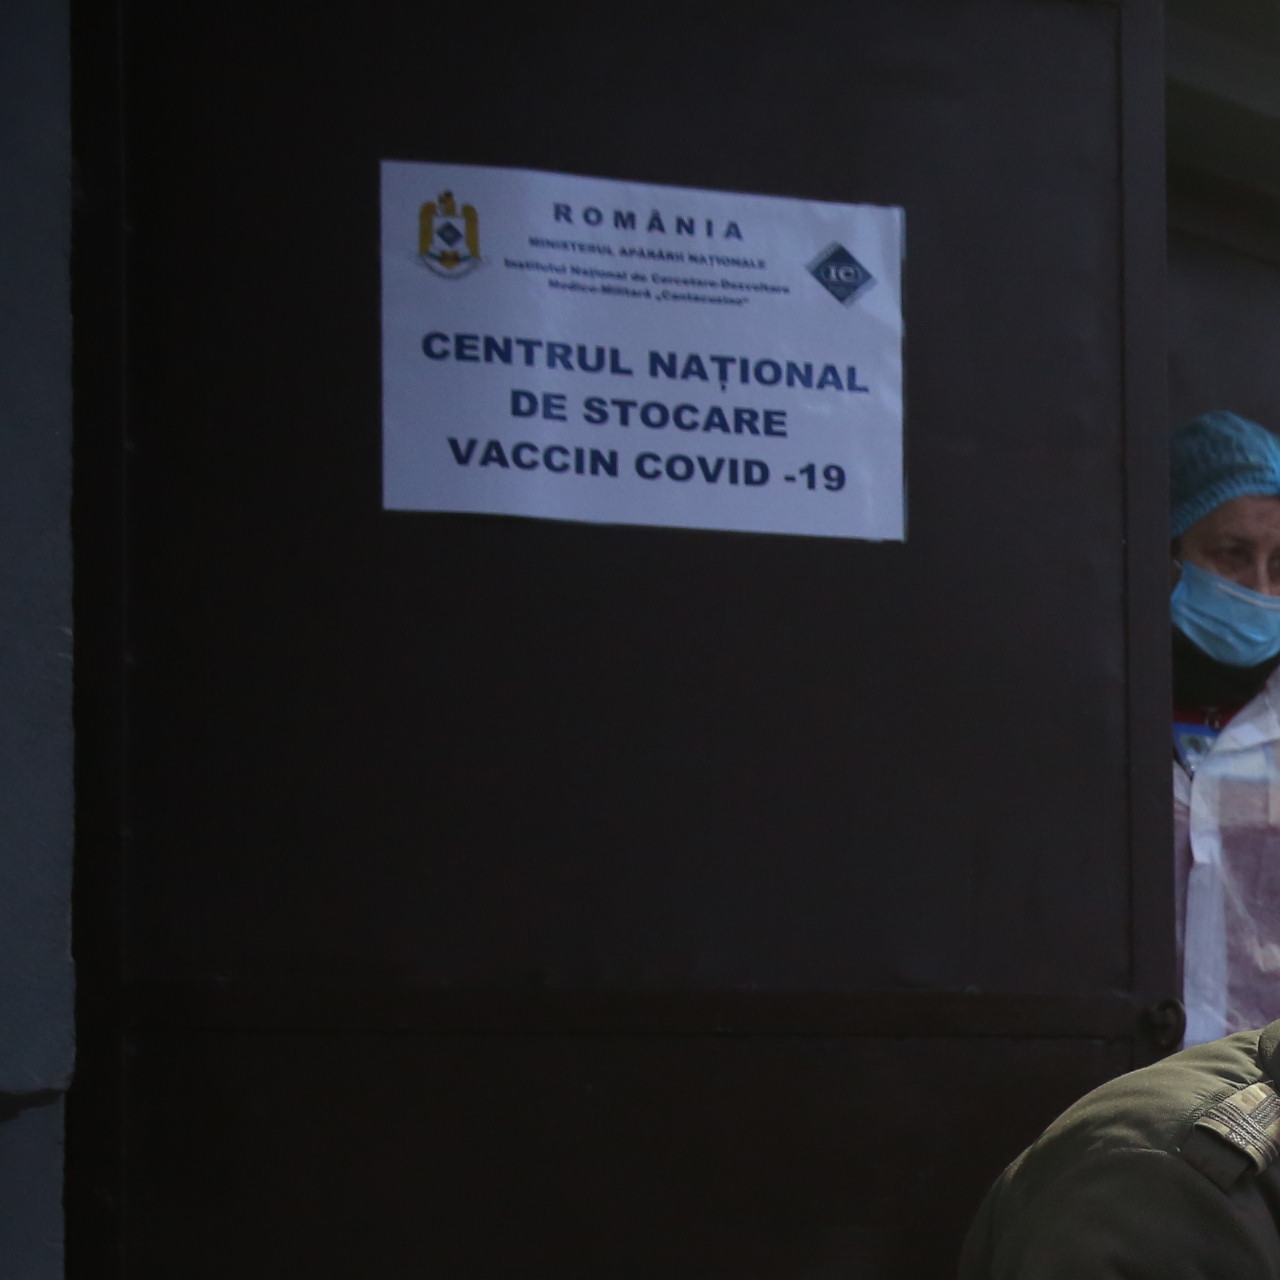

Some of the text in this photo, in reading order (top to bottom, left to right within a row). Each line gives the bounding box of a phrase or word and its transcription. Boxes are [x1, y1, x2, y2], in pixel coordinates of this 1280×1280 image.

[553, 202, 743, 240] ROMÂNIA
[421, 331, 870, 394] CENTRUL NAȚIONAL
[510, 389, 788, 438] DE STOCARE
[447, 436, 848, 492] VACCIN COVID -19
